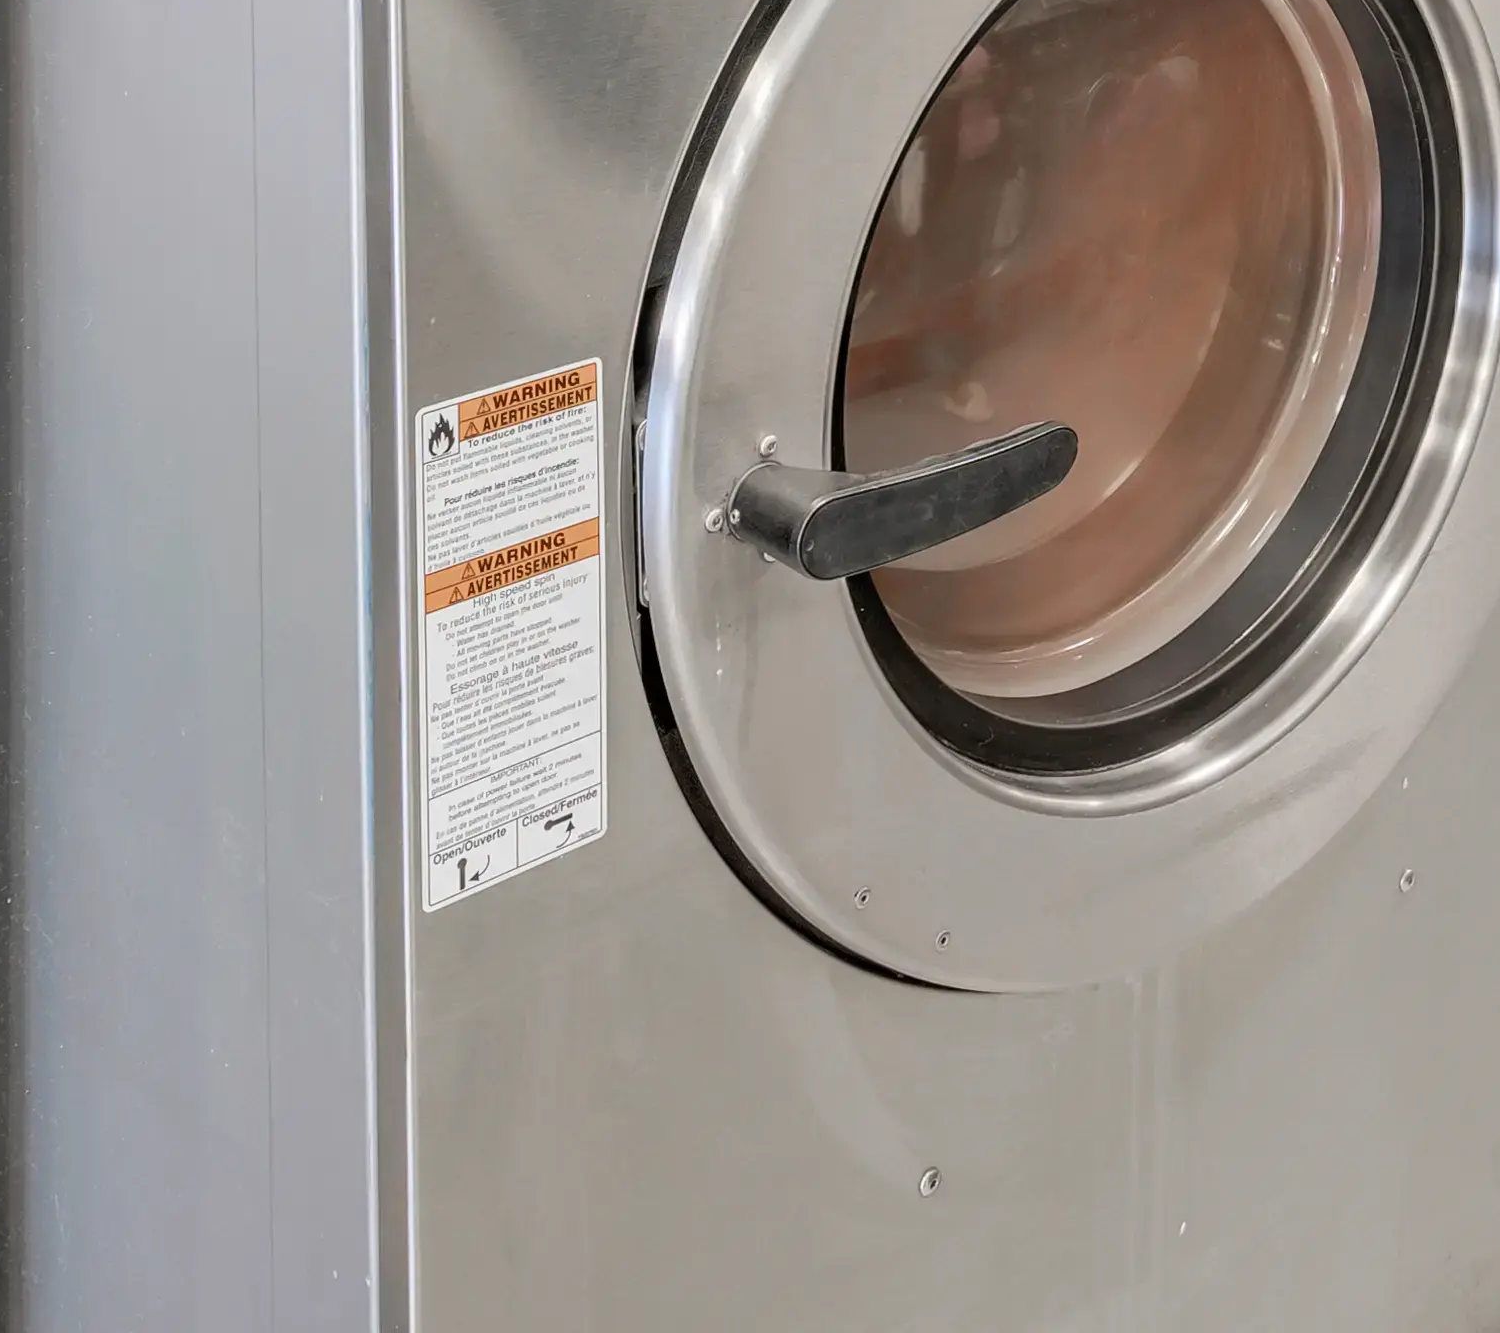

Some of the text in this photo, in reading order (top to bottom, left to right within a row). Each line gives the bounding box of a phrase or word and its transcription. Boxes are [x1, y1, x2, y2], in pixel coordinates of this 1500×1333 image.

[482, 386, 592, 431] AVERTISSEMENT
[492, 372, 580, 409] WARNING
[468, 439, 479, 448] To
[482, 428, 515, 443] reduce
[518, 421, 533, 433] the
[535, 416, 554, 428] risk
[556, 411, 565, 421] of
[444, 494, 462, 507] Pour
[467, 546, 578, 596] AVERTISSEMENT
[477, 532, 565, 573] WARNING
[437, 574, 588, 633] To reduce the risk of serious injury
[473, 573, 555, 608] High speed spin
[450, 670, 499, 694] Essorage
[511, 654, 540, 671] haute
[543, 641, 578, 658] vitesse
[522, 788, 597, 827] Closed/Fermée
[433, 828, 506, 865] Open/Ouverte
